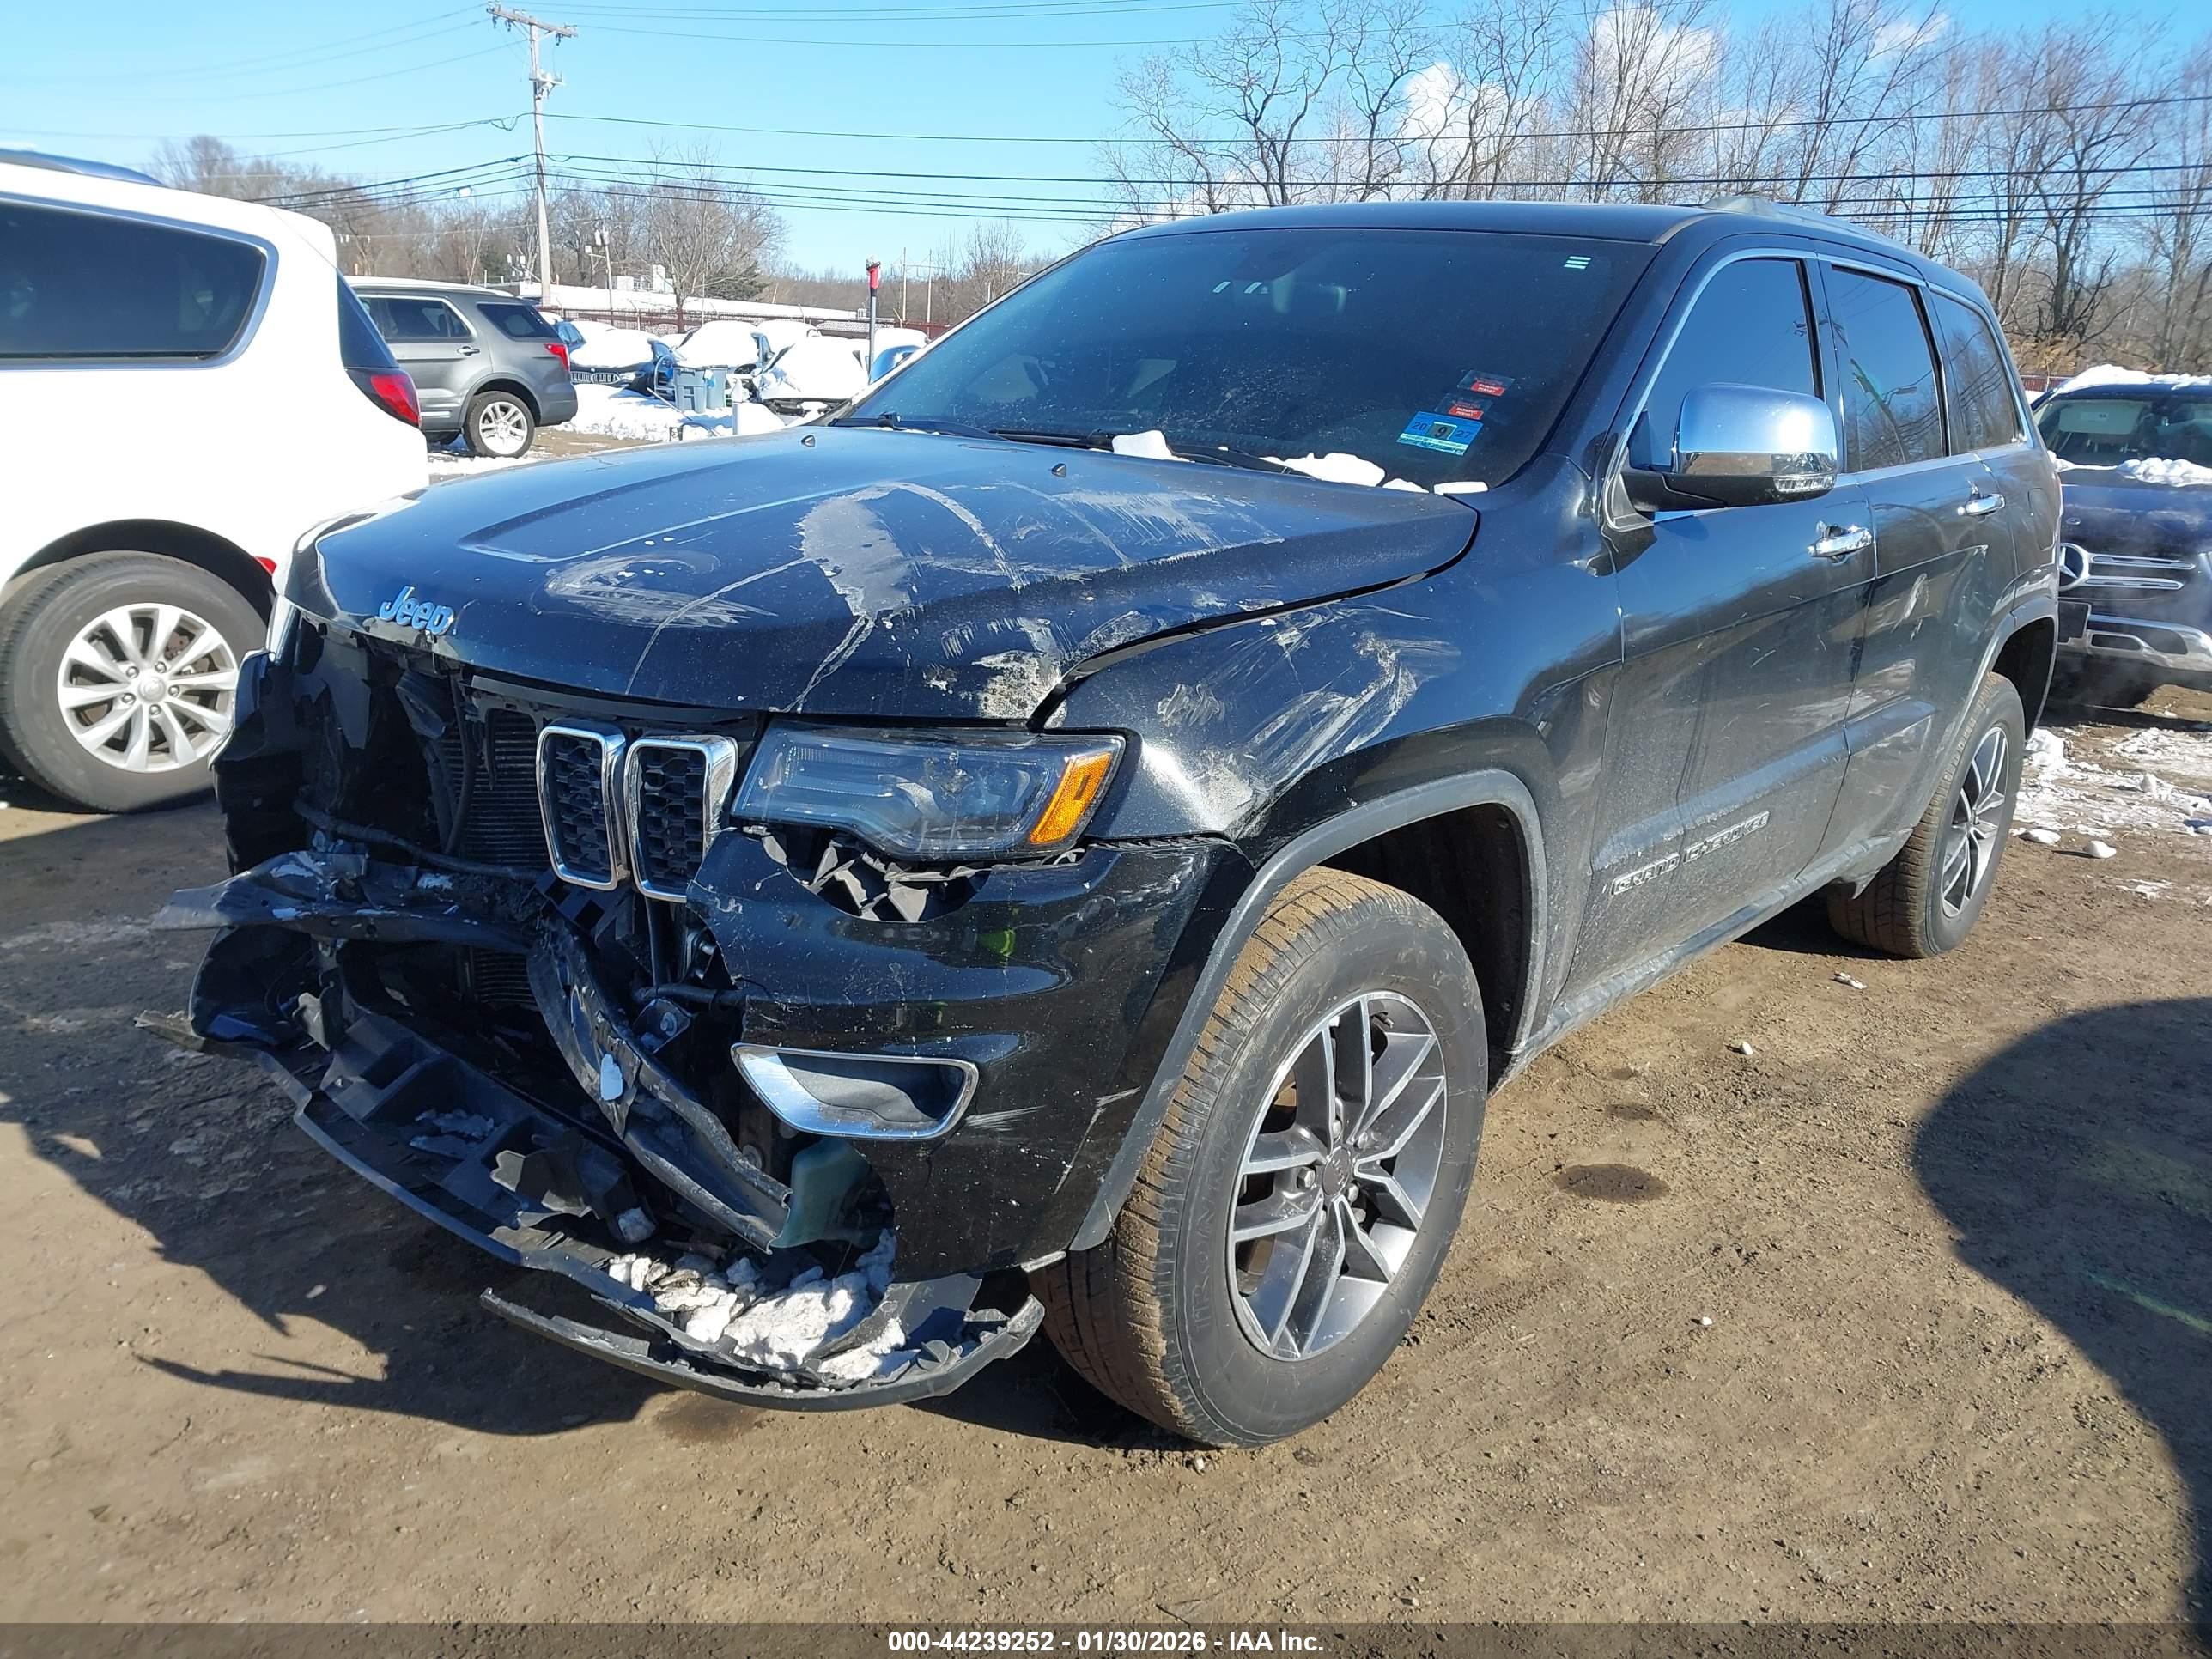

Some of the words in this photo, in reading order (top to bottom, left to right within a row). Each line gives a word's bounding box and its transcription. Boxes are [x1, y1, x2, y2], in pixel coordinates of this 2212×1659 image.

[1411, 422, 1427, 431] 20
[1434, 426, 1448, 438] 9
[1455, 430, 1473, 439] 27
[379, 585, 455, 641] Jeep
